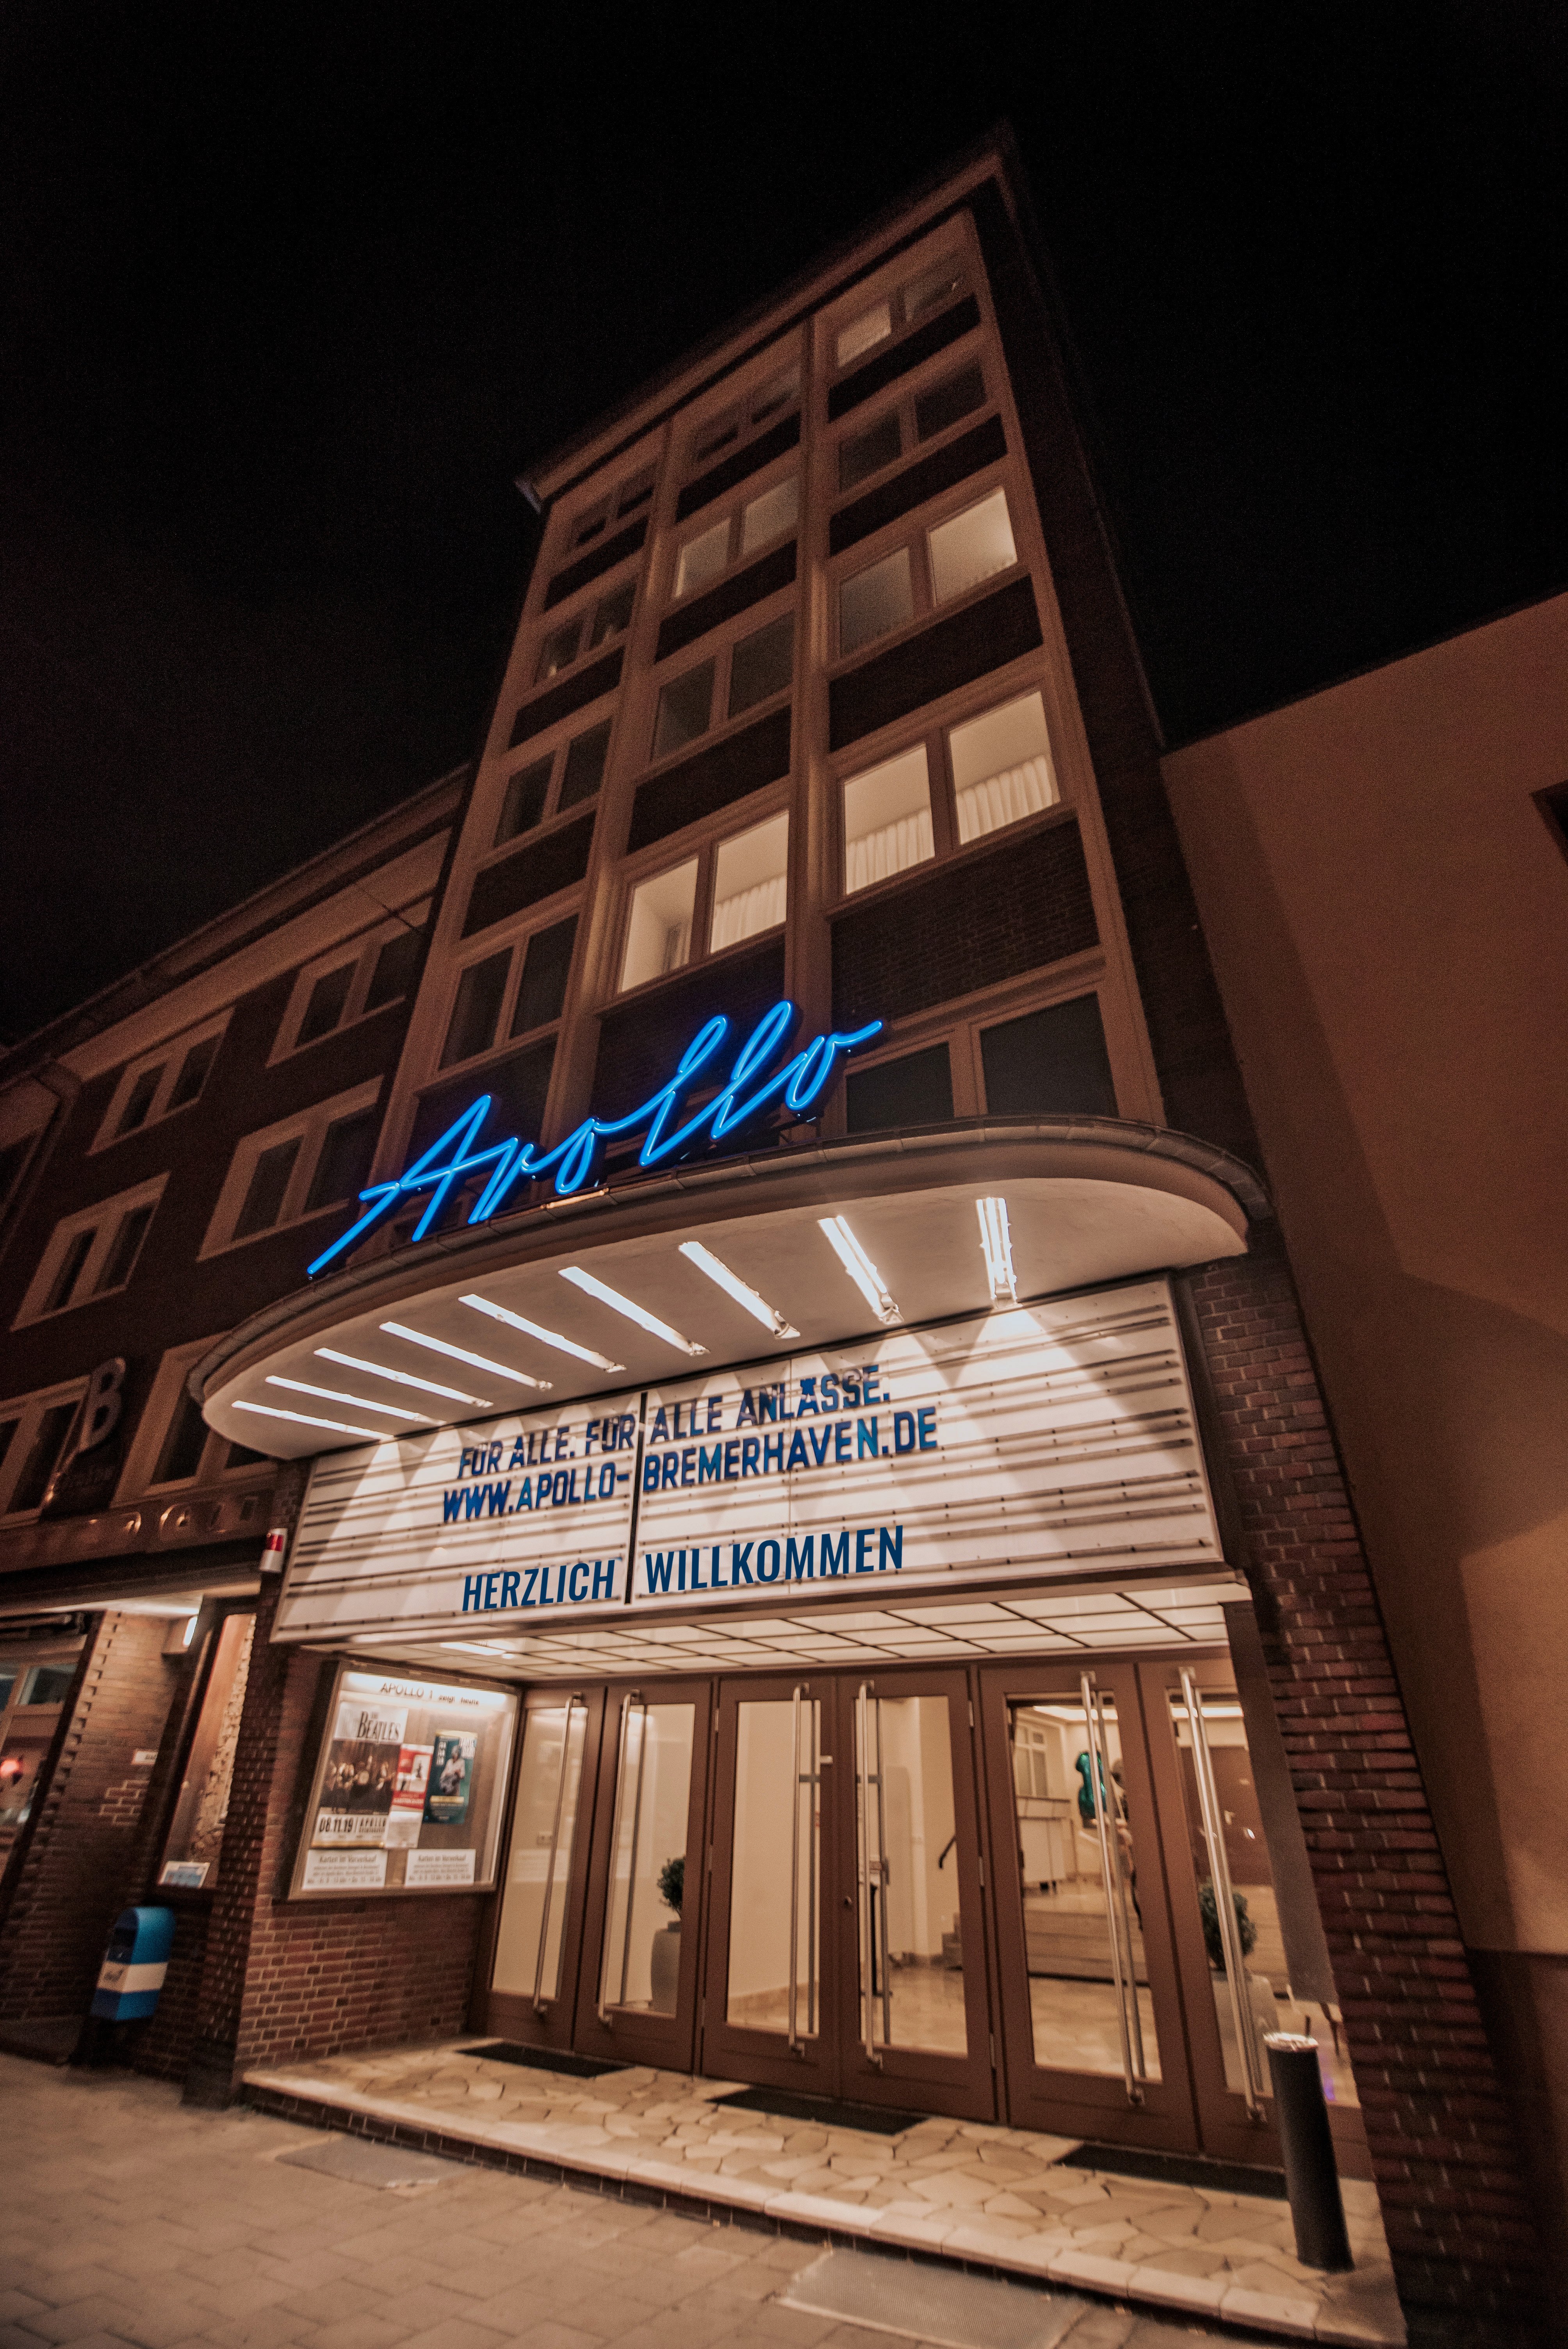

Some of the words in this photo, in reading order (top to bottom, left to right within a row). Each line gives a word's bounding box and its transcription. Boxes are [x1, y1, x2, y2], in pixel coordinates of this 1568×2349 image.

[306, 999, 884, 1274] Apollo
[444, 1461, 630, 1524] WWW.APOLLO-
[642, 1406, 938, 1492] BREMERHAVEN.DE
[508, 1426, 576, 1470] ALLE.
[650, 1395, 725, 1444] ALLE
[462, 1559, 615, 1611] HERZLICH
[645, 1525, 903, 1594] WILLKOMMEN
[357, 1711, 401, 1743] BEATLES
[380, 1682, 425, 1697] APOLLO
[319, 1817, 353, 1833] 08.11.19
